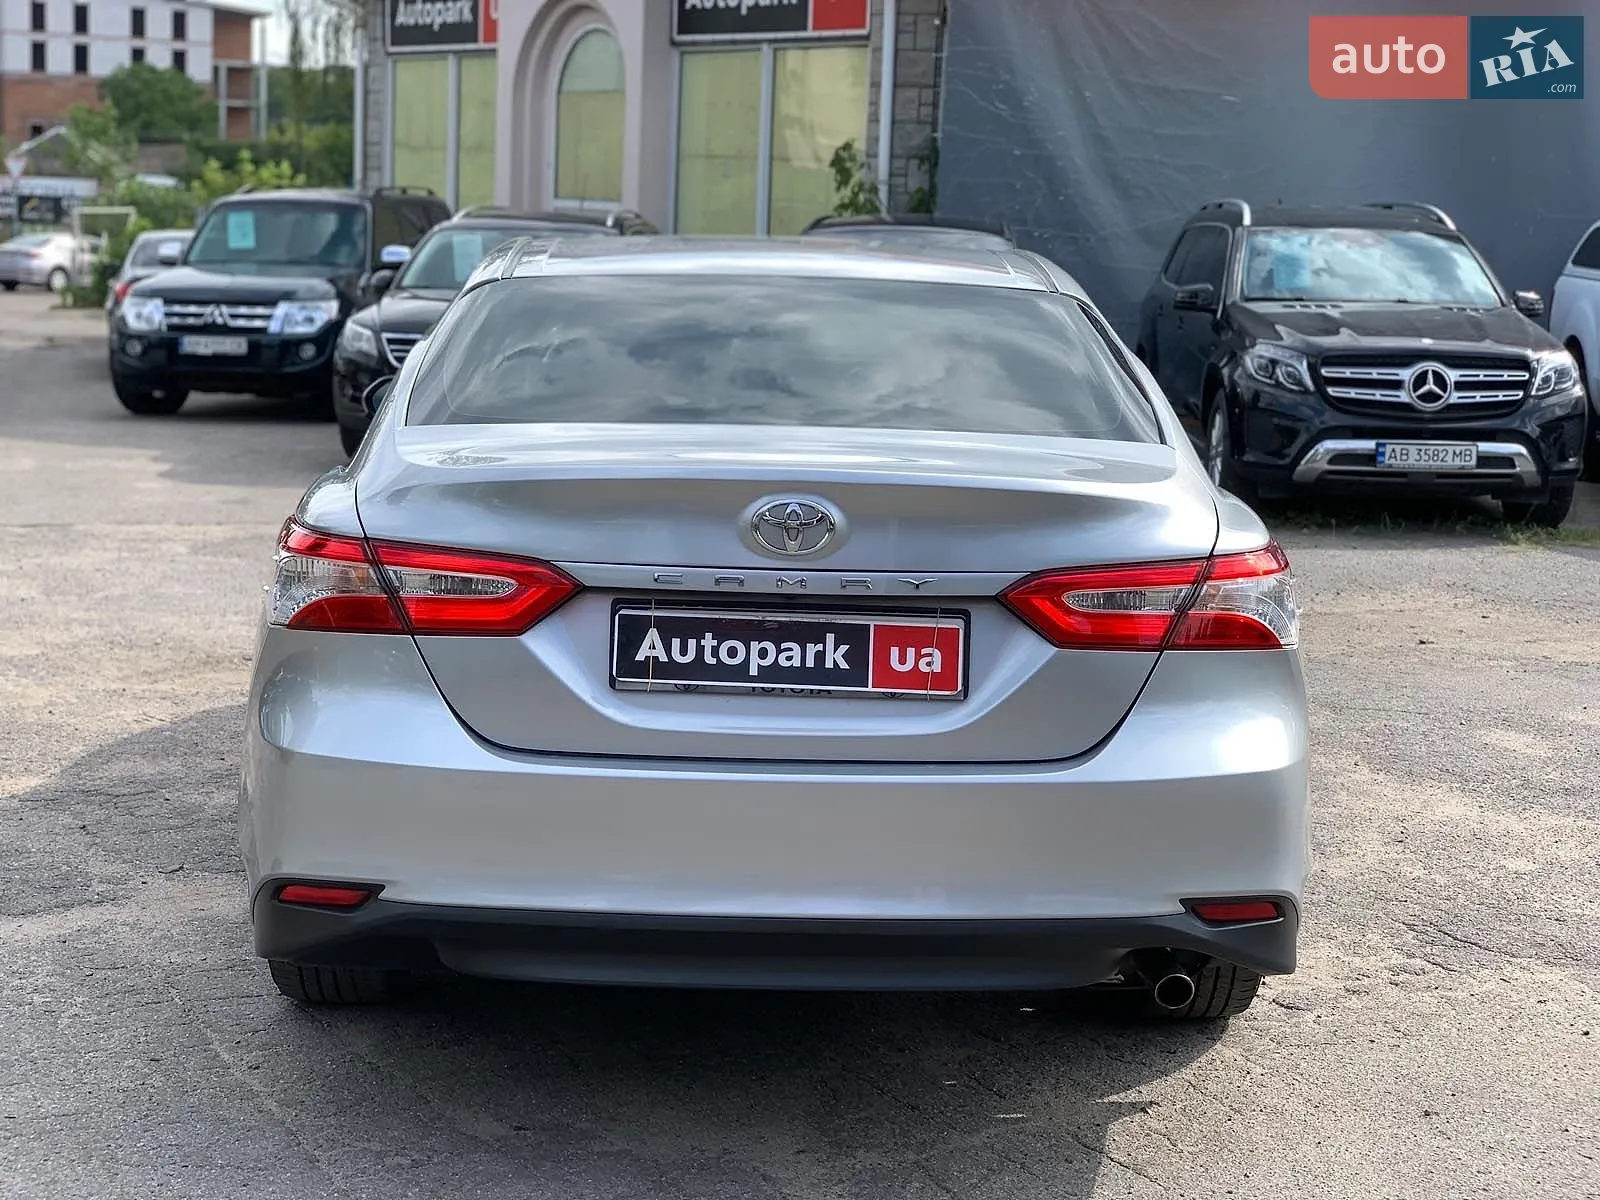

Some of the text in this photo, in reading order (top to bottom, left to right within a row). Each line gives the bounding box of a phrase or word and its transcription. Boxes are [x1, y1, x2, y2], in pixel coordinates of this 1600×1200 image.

[394, 0, 474, 32] Autopark
[1387, 447, 1473, 463] AB 3582 MB
[652, 572, 939, 591] CAMRY
[634, 627, 943, 677] Autopark ua
